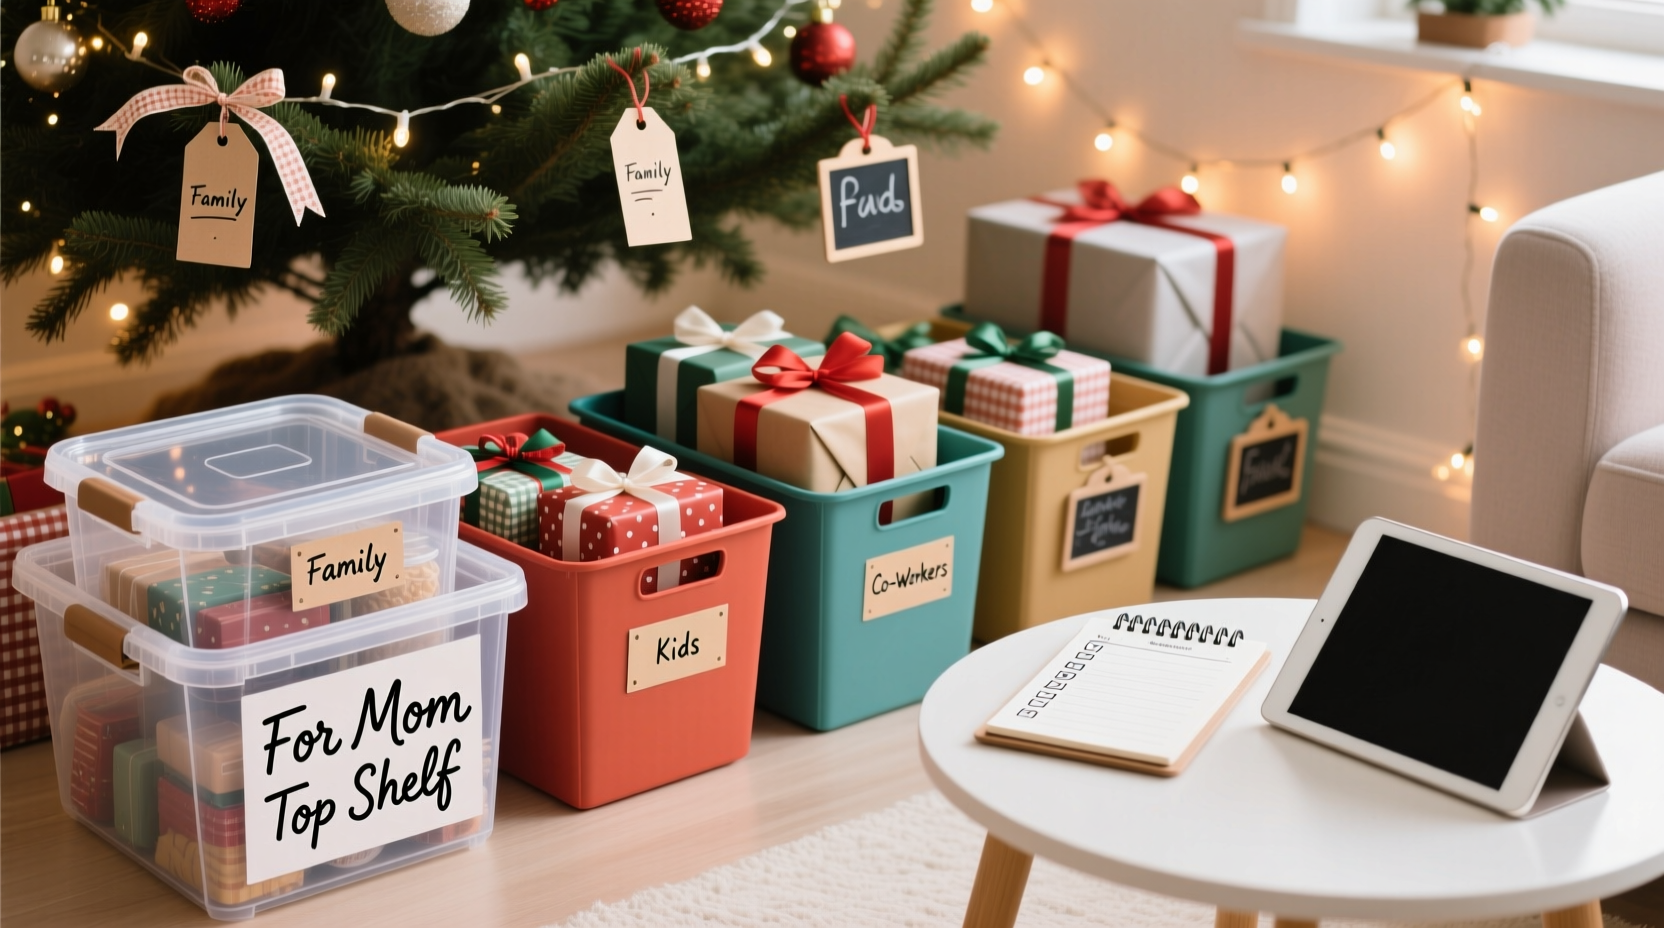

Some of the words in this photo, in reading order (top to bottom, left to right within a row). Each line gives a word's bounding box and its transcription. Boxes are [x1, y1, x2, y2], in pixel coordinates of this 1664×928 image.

[624, 159, 672, 187] Family
[190, 184, 248, 217] Family
[306, 542, 387, 586] Family
[872, 561, 948, 595] Co-Workers
[656, 630, 700, 665] Kids
[262, 704, 342, 776] For
[351, 678, 472, 750] Mom
[264, 781, 336, 850] Top
[348, 738, 462, 822] Shelf
